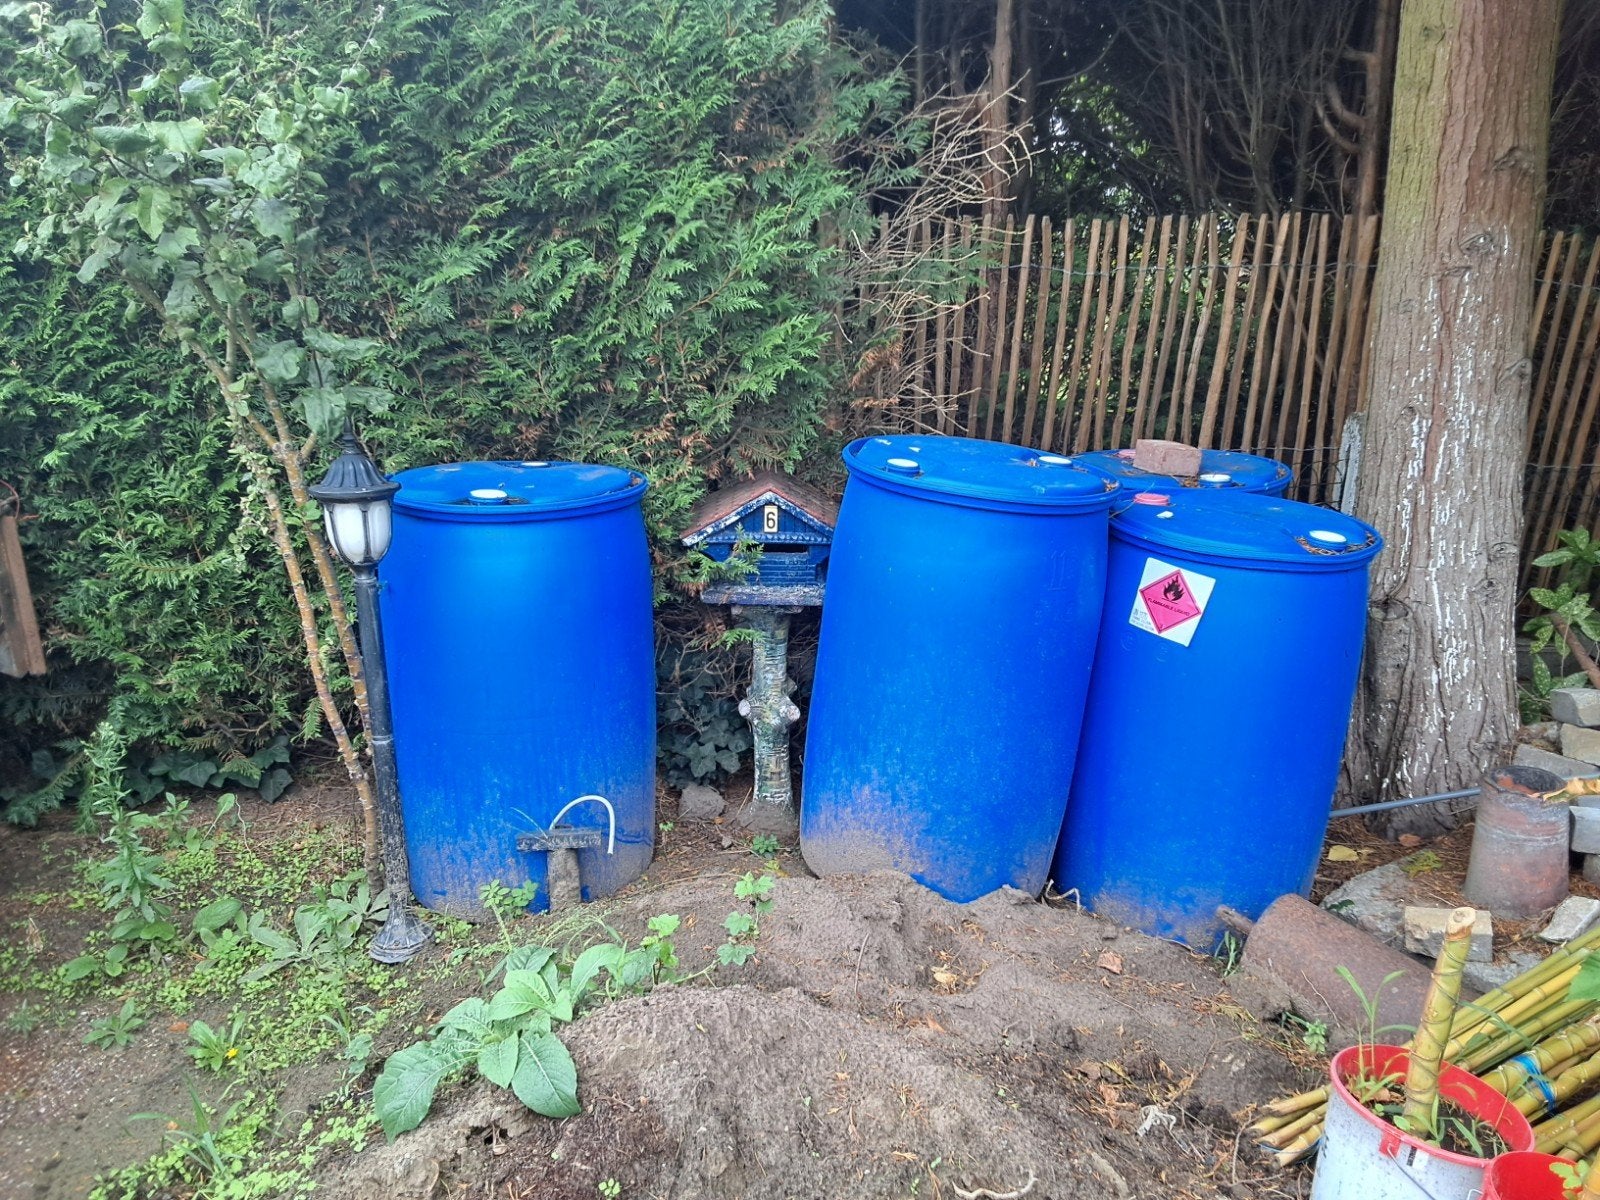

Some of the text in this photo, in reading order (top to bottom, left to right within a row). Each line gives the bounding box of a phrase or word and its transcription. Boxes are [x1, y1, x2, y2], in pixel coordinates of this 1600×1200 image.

[766, 511, 776, 529] 6
[1147, 597, 1190, 616] FLAMMABLE LIQUID
